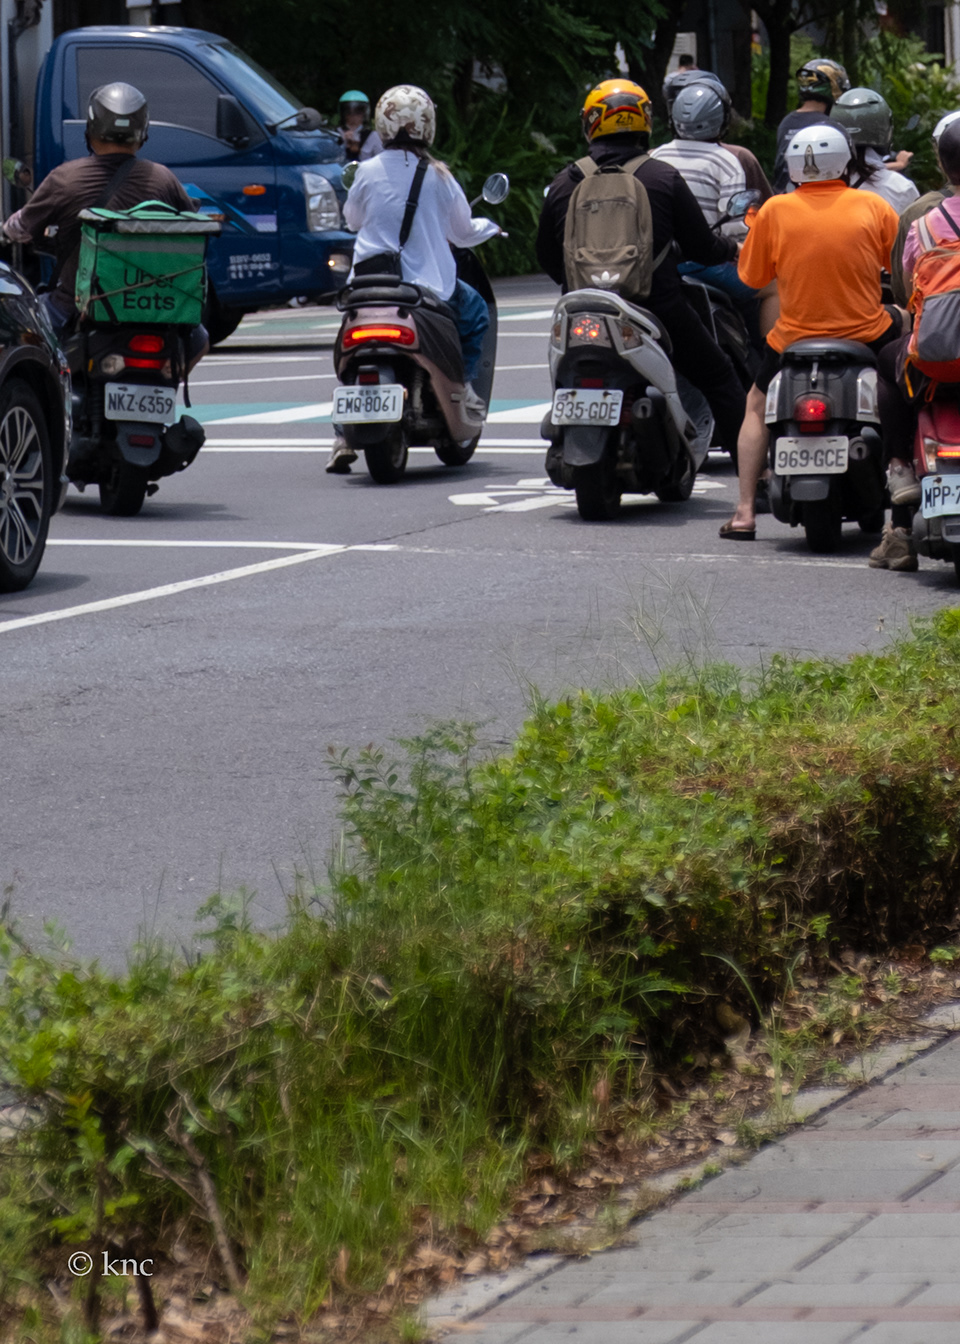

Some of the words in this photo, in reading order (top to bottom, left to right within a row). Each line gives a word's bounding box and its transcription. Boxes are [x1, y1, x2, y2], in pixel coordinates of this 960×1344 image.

[124, 268, 173, 289] Uber
[122, 292, 175, 311] Eats
[107, 393, 173, 415] NKZ-6359
[337, 395, 396, 414] EMQ-8061
[554, 401, 619, 420] 935-GDE
[778, 448, 846, 468] 969-GCE
